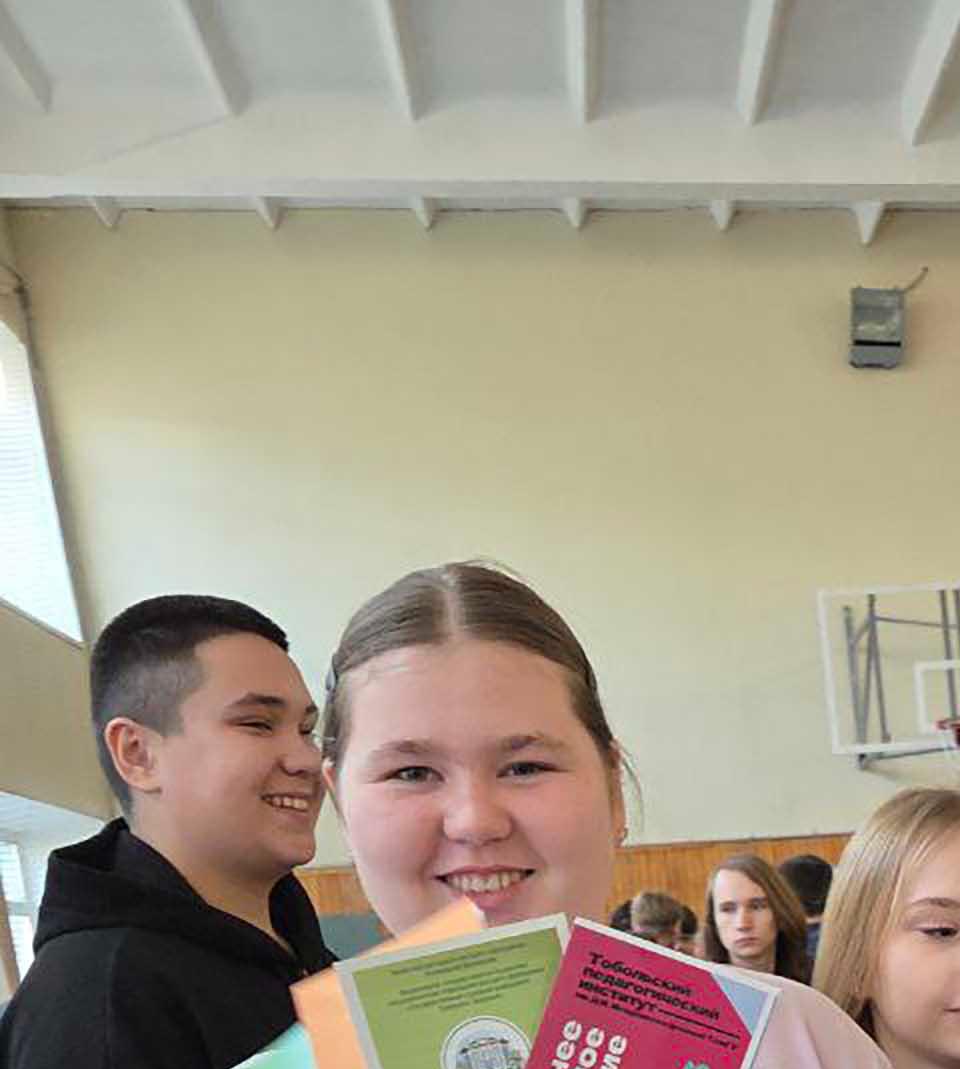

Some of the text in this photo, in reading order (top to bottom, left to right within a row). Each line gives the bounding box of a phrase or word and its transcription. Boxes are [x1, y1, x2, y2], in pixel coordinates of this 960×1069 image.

[578, 979, 658, 1012] институт
[582, 966, 720, 1021] педагогический
[589, 951, 692, 997] Тобольский
